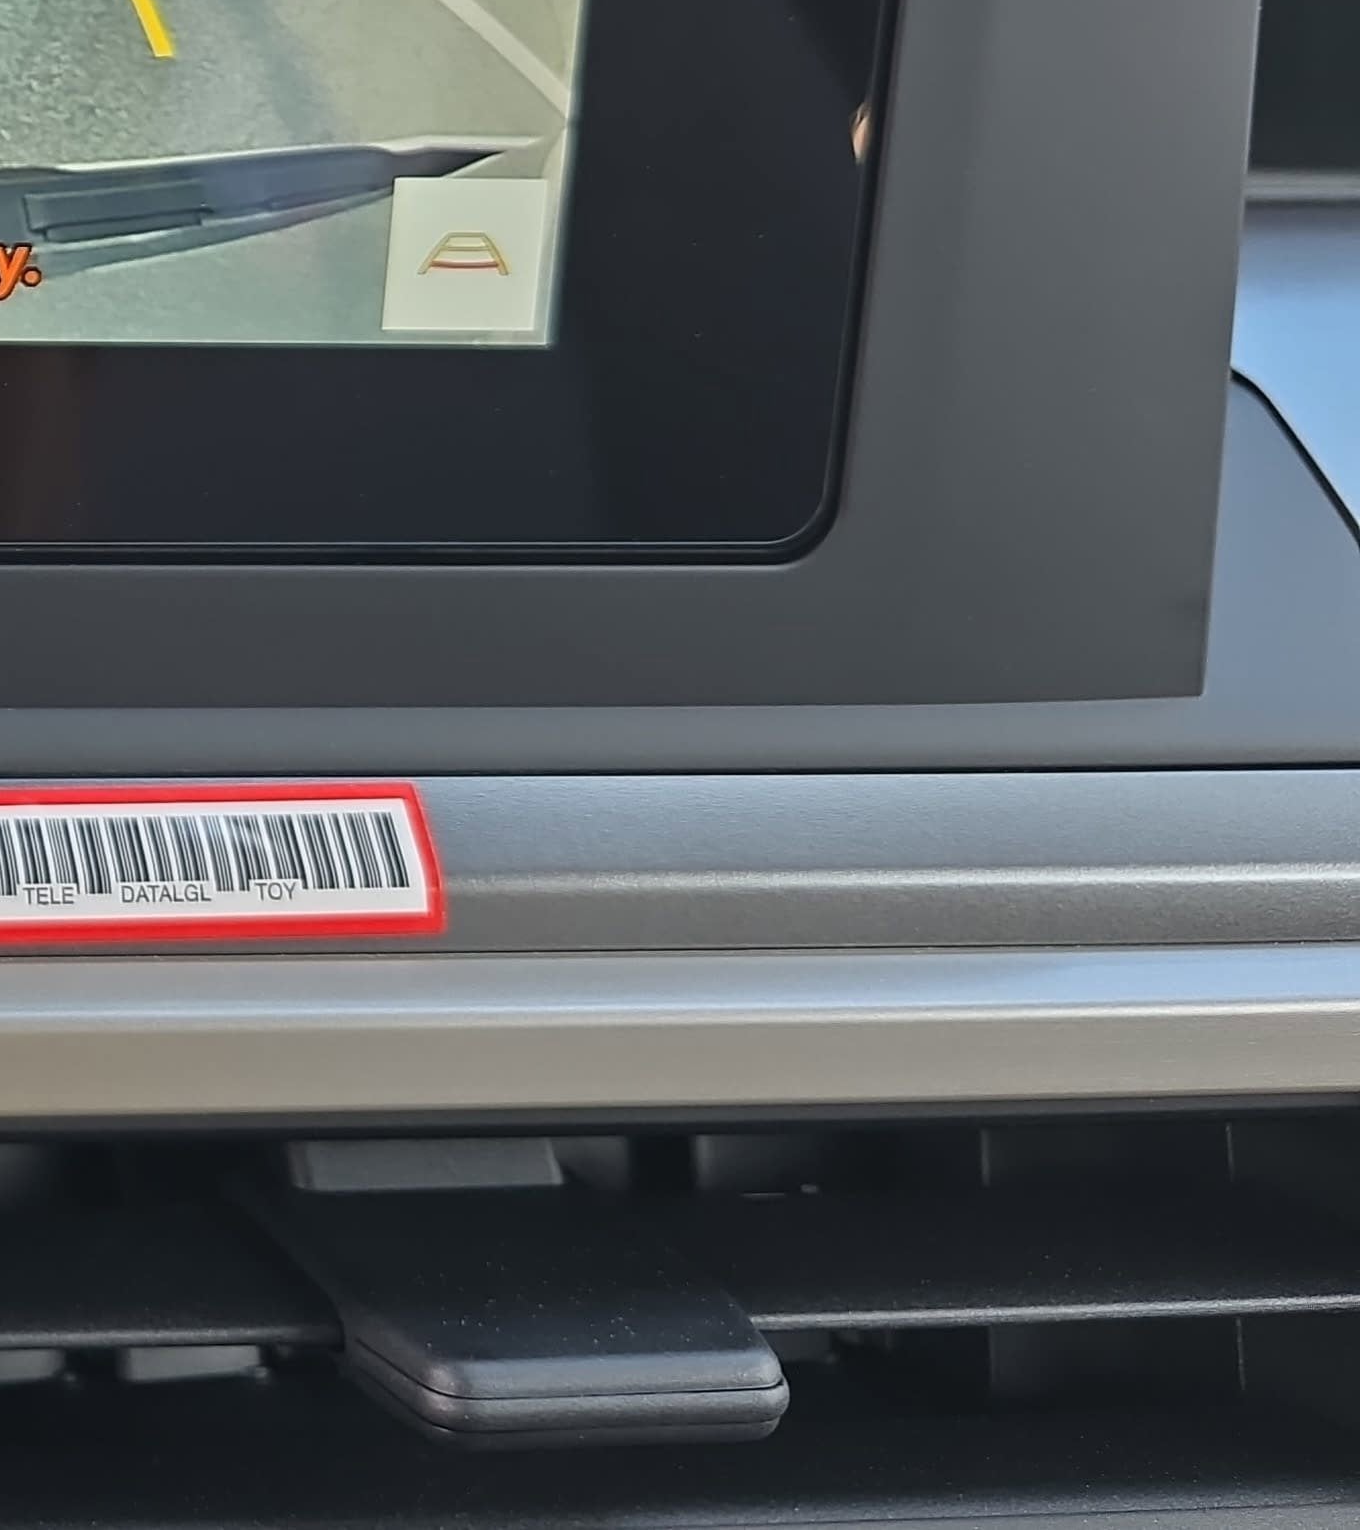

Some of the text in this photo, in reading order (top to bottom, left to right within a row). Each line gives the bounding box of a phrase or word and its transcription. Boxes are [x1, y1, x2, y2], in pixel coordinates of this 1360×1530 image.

[22, 880, 298, 907] TELE DATALGL TOY
